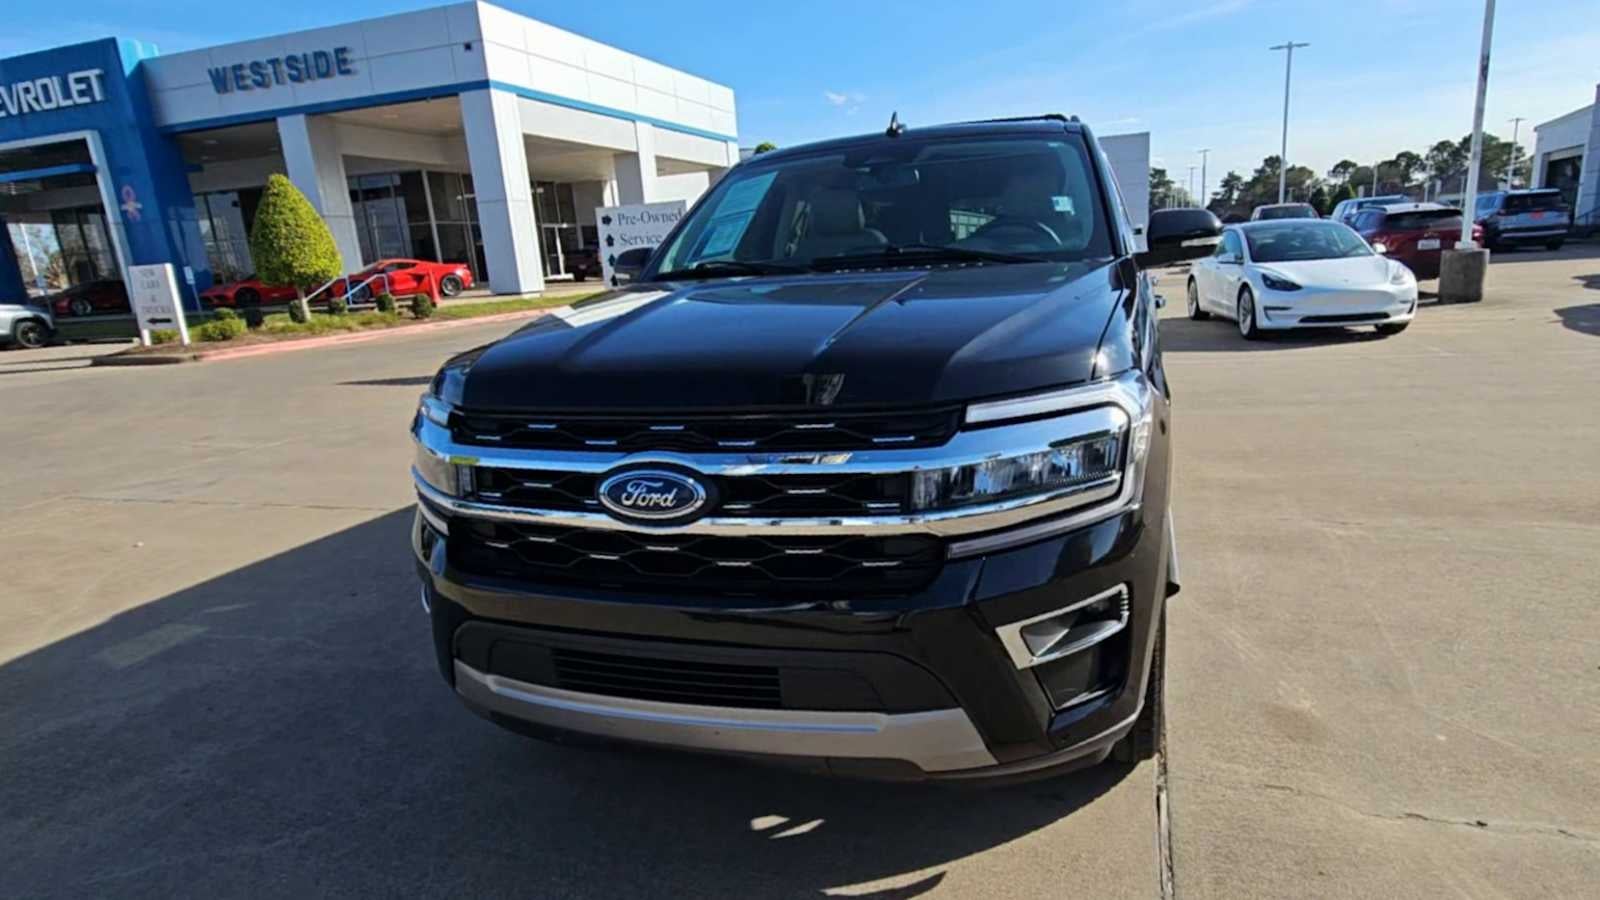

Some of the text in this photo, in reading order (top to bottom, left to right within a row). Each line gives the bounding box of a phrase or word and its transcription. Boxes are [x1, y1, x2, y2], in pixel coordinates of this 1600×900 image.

[207, 46, 354, 95] WESTSIDE
[617, 208, 682, 225] Pre-Owned
[620, 232, 663, 246] Service
[621, 480, 678, 507] Ford
